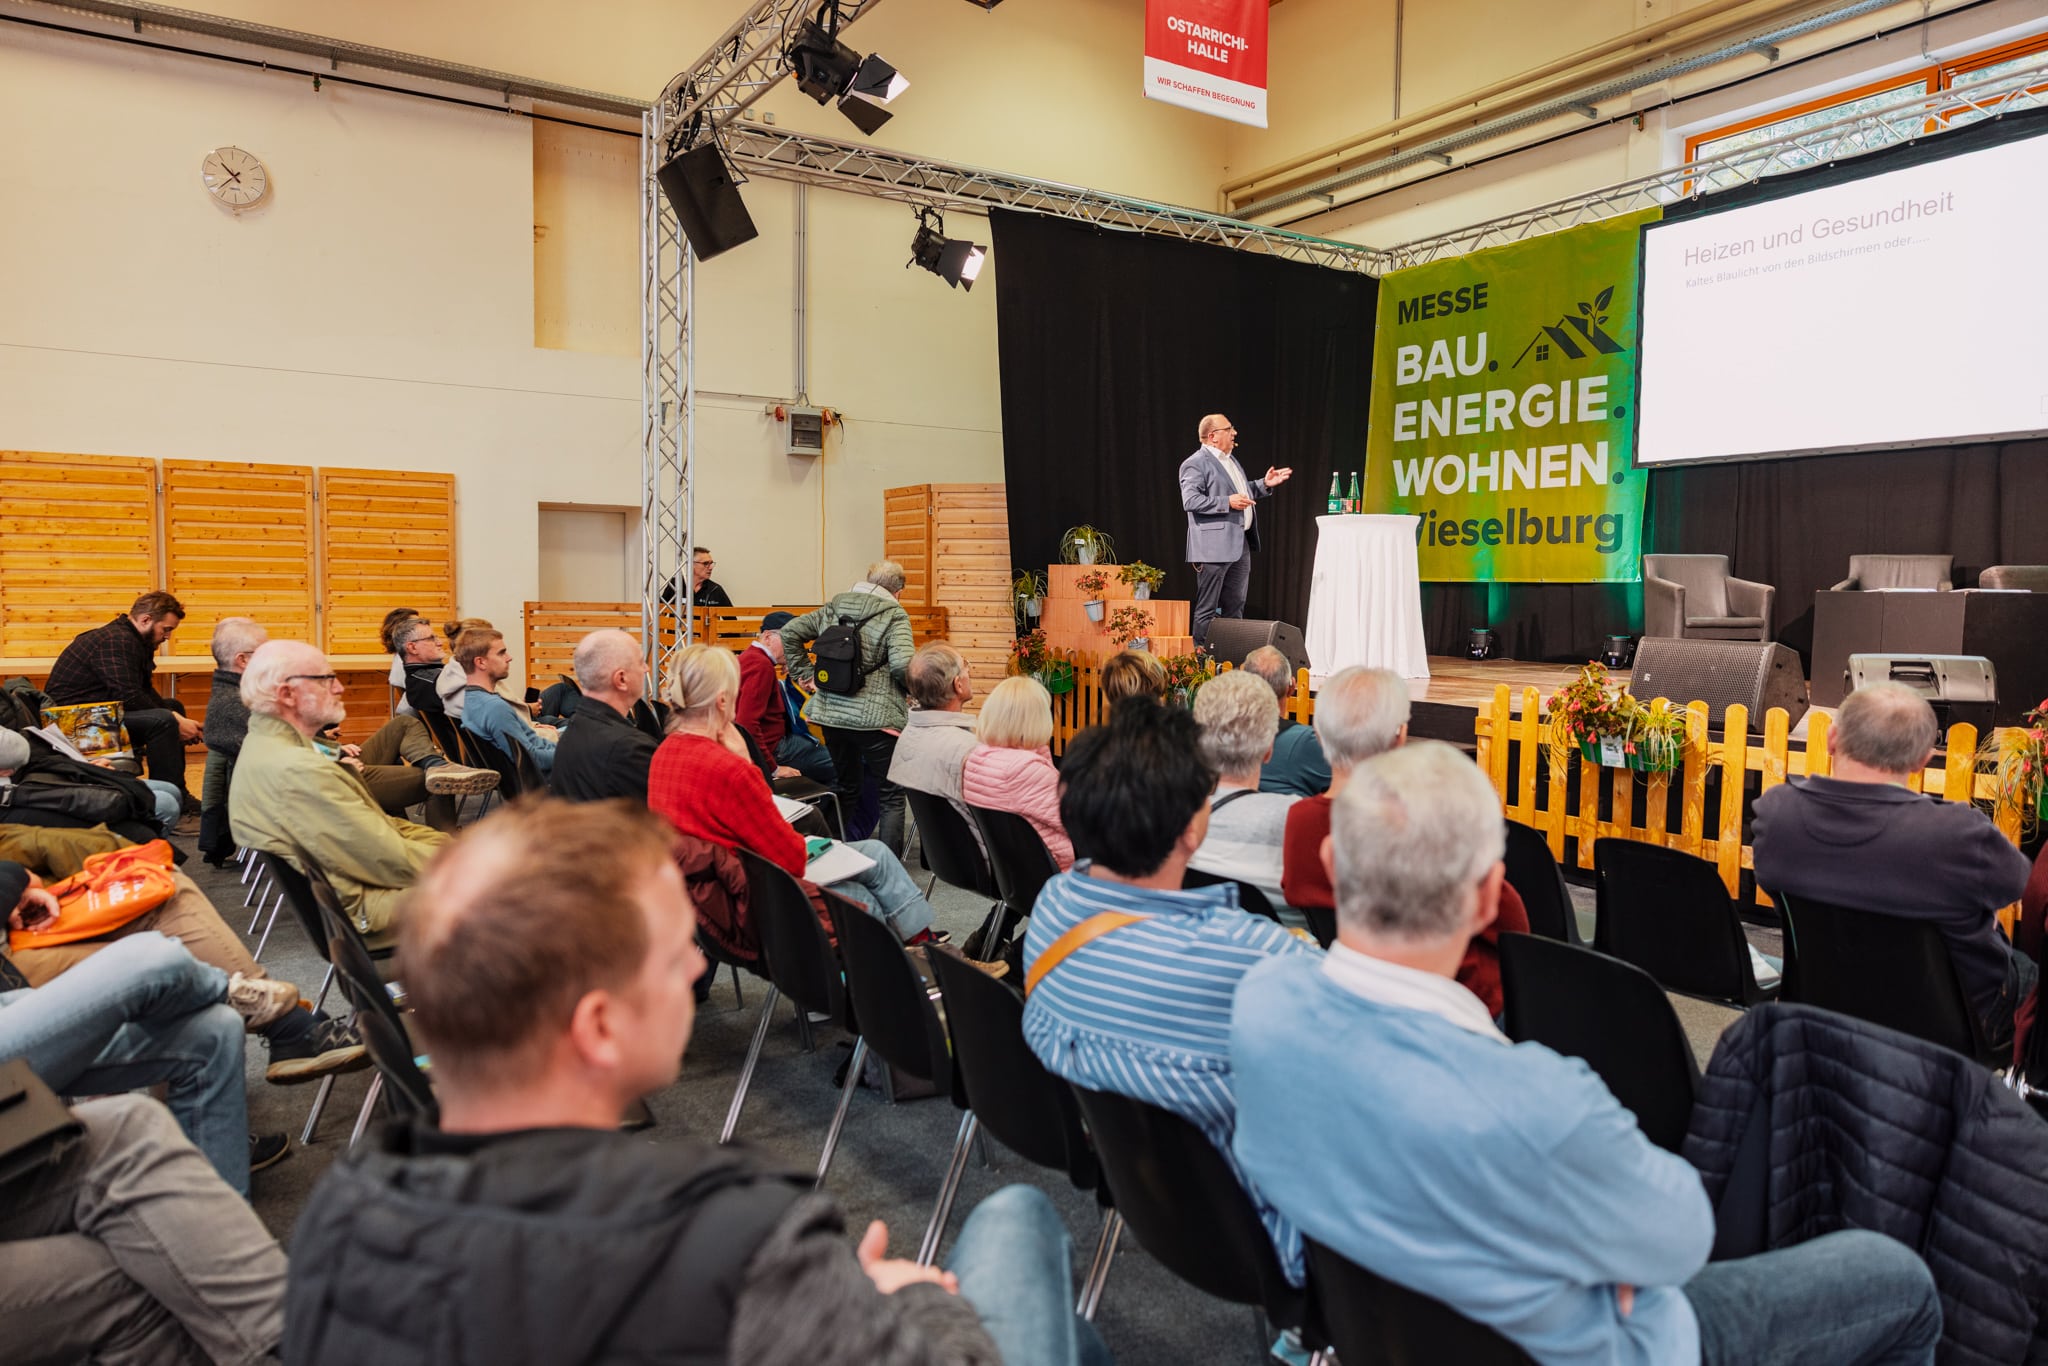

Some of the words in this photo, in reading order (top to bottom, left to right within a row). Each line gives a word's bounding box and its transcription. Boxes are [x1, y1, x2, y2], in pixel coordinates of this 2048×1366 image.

[1167, 16, 1249, 51] OSTARRICHI-
[1187, 40, 1229, 63] HALLE
[1157, 76, 1171, 87] WIR
[1173, 81, 1211, 97] SCHAFFEN
[1212, 92, 1256, 109] BEGEGNUNG
[1685, 239, 1754, 266] Heizen
[1763, 224, 1803, 250] und
[1812, 192, 1954, 239] Gesundheit
[1686, 275, 1714, 288] Kaltes
[1717, 266, 1759, 282] Blaulicht
[1762, 263, 1781, 273] von
[1784, 257, 1804, 269] den
[1808, 242, 1880, 264] Bildschirmen
[1398, 282, 1489, 325] MESSE
[1396, 332, 1499, 387] BAU.
[1393, 375, 1626, 442] ENERGIE.
[1392, 441, 1625, 497] WOHNEN.
[1415, 507, 1624, 554] ieselburg
